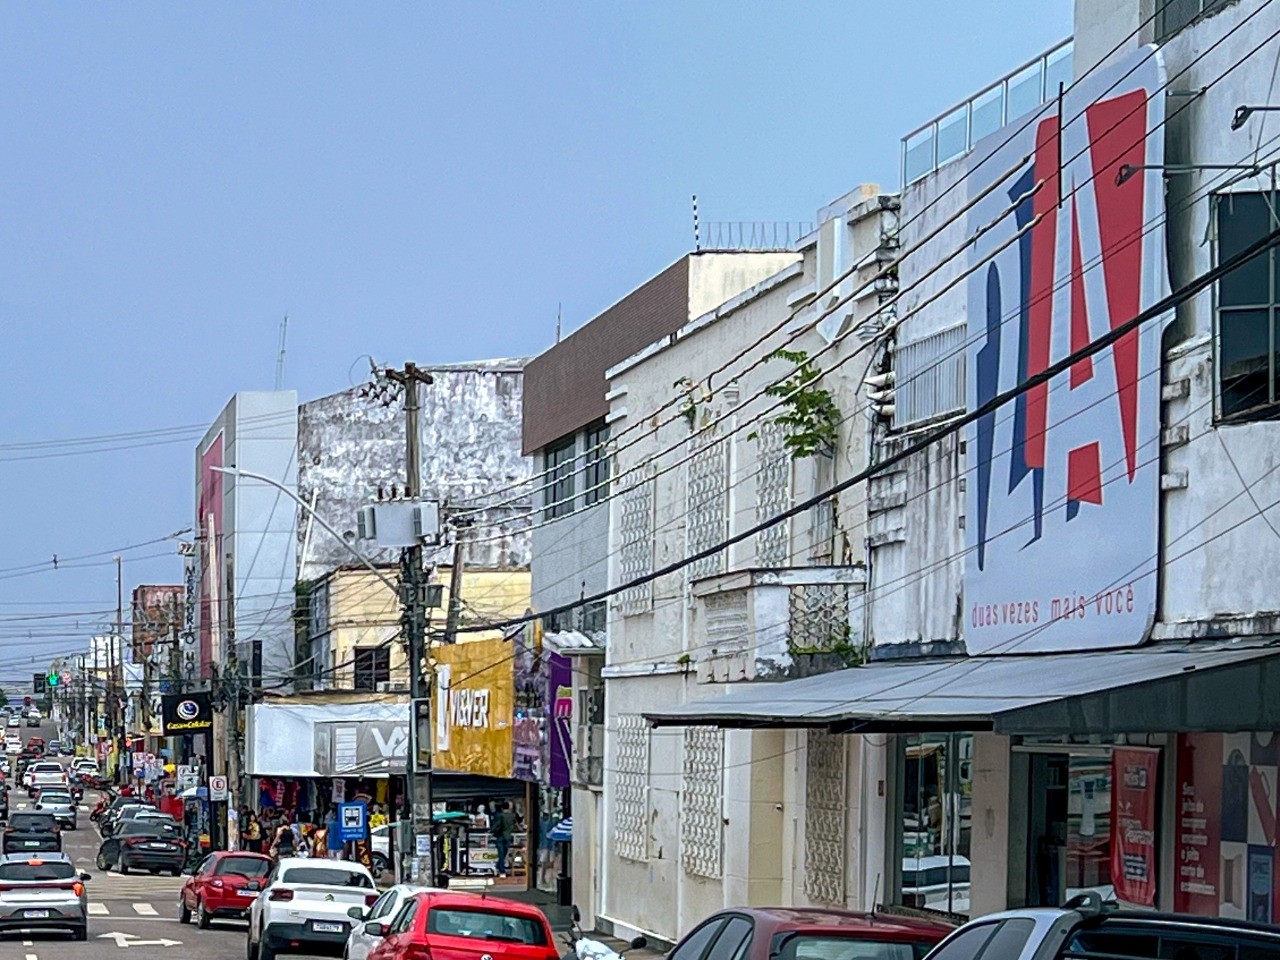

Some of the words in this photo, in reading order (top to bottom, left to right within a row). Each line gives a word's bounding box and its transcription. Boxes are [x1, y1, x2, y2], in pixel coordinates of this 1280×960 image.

[971, 601, 999, 629] duas
[1001, 596, 1040, 626] vezes
[1050, 589, 1087, 620] mais
[1094, 582, 1135, 617] você
